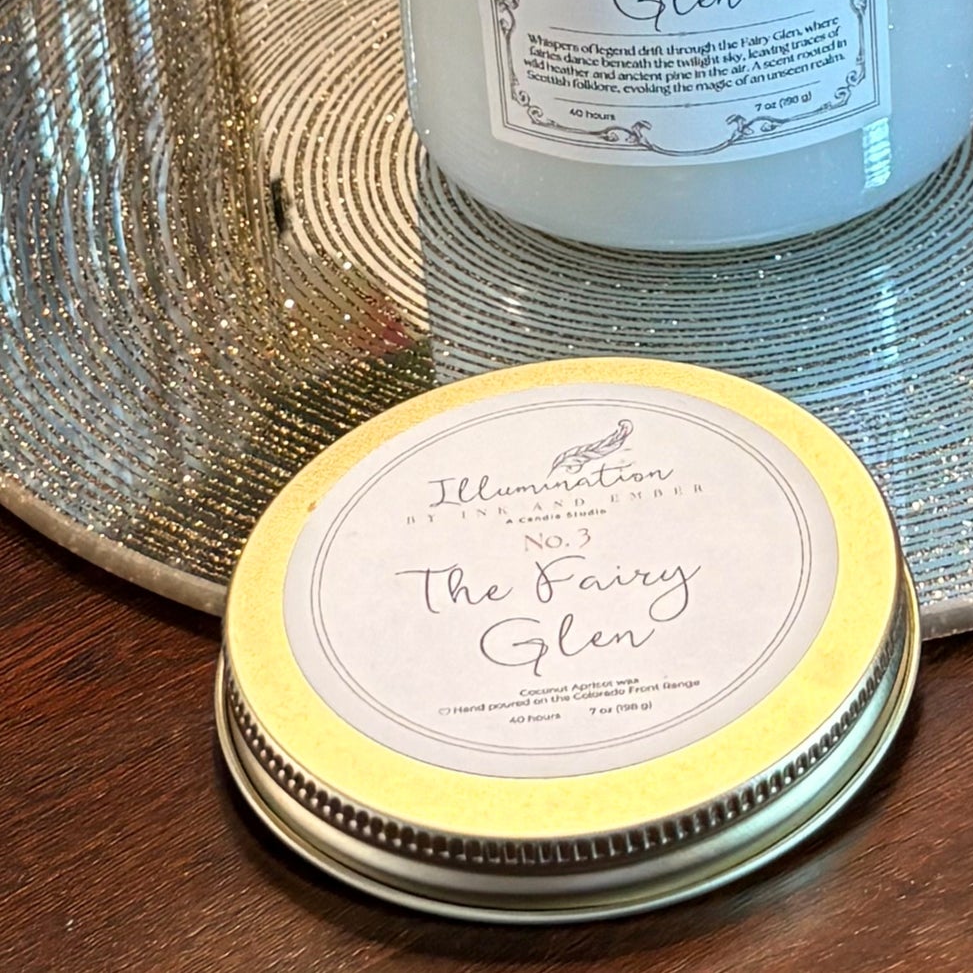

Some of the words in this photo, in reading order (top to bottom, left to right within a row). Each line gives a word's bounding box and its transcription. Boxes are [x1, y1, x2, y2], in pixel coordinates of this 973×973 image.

[527, 33, 579, 53] Whispers
[581, 43, 596, 53] of
[596, 44, 636, 58] legend
[638, 45, 663, 56] drift
[667, 40, 716, 56] through
[718, 39, 738, 52] the
[741, 35, 770, 49] Fairy
[772, 28, 803, 42] Glen,
[804, 16, 839, 34] where
[530, 45, 562, 61] fairies
[564, 52, 600, 67] dance
[601, 57, 652, 69] beneath
[654, 57, 674, 69] the
[676, 53, 720, 69] twilight
[722, 51, 747, 63] sky,
[748, 43, 790, 59] leaving
[791, 34, 826, 50] traces
[828, 25, 841, 40] of
[524, 58, 544, 70] wild
[546, 59, 589, 78] heather
[592, 69, 616, 81] and
[618, 70, 663, 81] ancient
[665, 69, 692, 84] pine
[694, 69, 707, 79] in
[708, 66, 729, 78] the
[731, 62, 750, 74] air.
[752, 61, 762, 71] A
[763, 55, 795, 69] scent
[796, 42, 836, 60] rooted
[837, 38, 848, 49] in
[526, 69, 571, 87] Scottish
[572, 77, 621, 94] folklore,
[623, 82, 672, 96] evoking
[673, 83, 694, 94] the
[695, 78, 733, 93] magic
[735, 75, 749, 87] of
[749, 74, 766, 84] an
[767, 64, 809, 80] unseen
[810, 52, 846, 70] realm.
[569, 108, 584, 118] 40
[585, 110, 616, 121] hours
[754, 102, 762, 112] 7
[764, 101, 777, 110] oz
[801, 90, 813, 104] g)
[428, 461, 674, 508] Illumination
[462, 506, 508, 519] INK
[533, 497, 586, 512] AND
[610, 483, 704, 503] EMBER
[525, 532, 570, 552] No.
[577, 527, 591, 549] 3
[395, 563, 513, 614] The
[535, 555, 701, 622] Fairy
[479, 613, 656, 677] Glen
[453, 703, 486, 714] Hand
[488, 697, 531, 712] poured
[533, 697, 548, 705] on
[551, 694, 570, 704] the
[572, 687, 626, 701] Colorado
[628, 683, 660, 695] Front
[662, 679, 701, 690] Range
[519, 685, 568, 697] Coconut
[571, 680, 613, 692] Apricot
[616, 677, 640, 686] wax
[509, 714, 526, 724] 40
[527, 712, 562, 723] hours
[588, 707, 597, 716] 7
[599, 706, 613, 715] oz
[641, 700, 653, 711] g)
